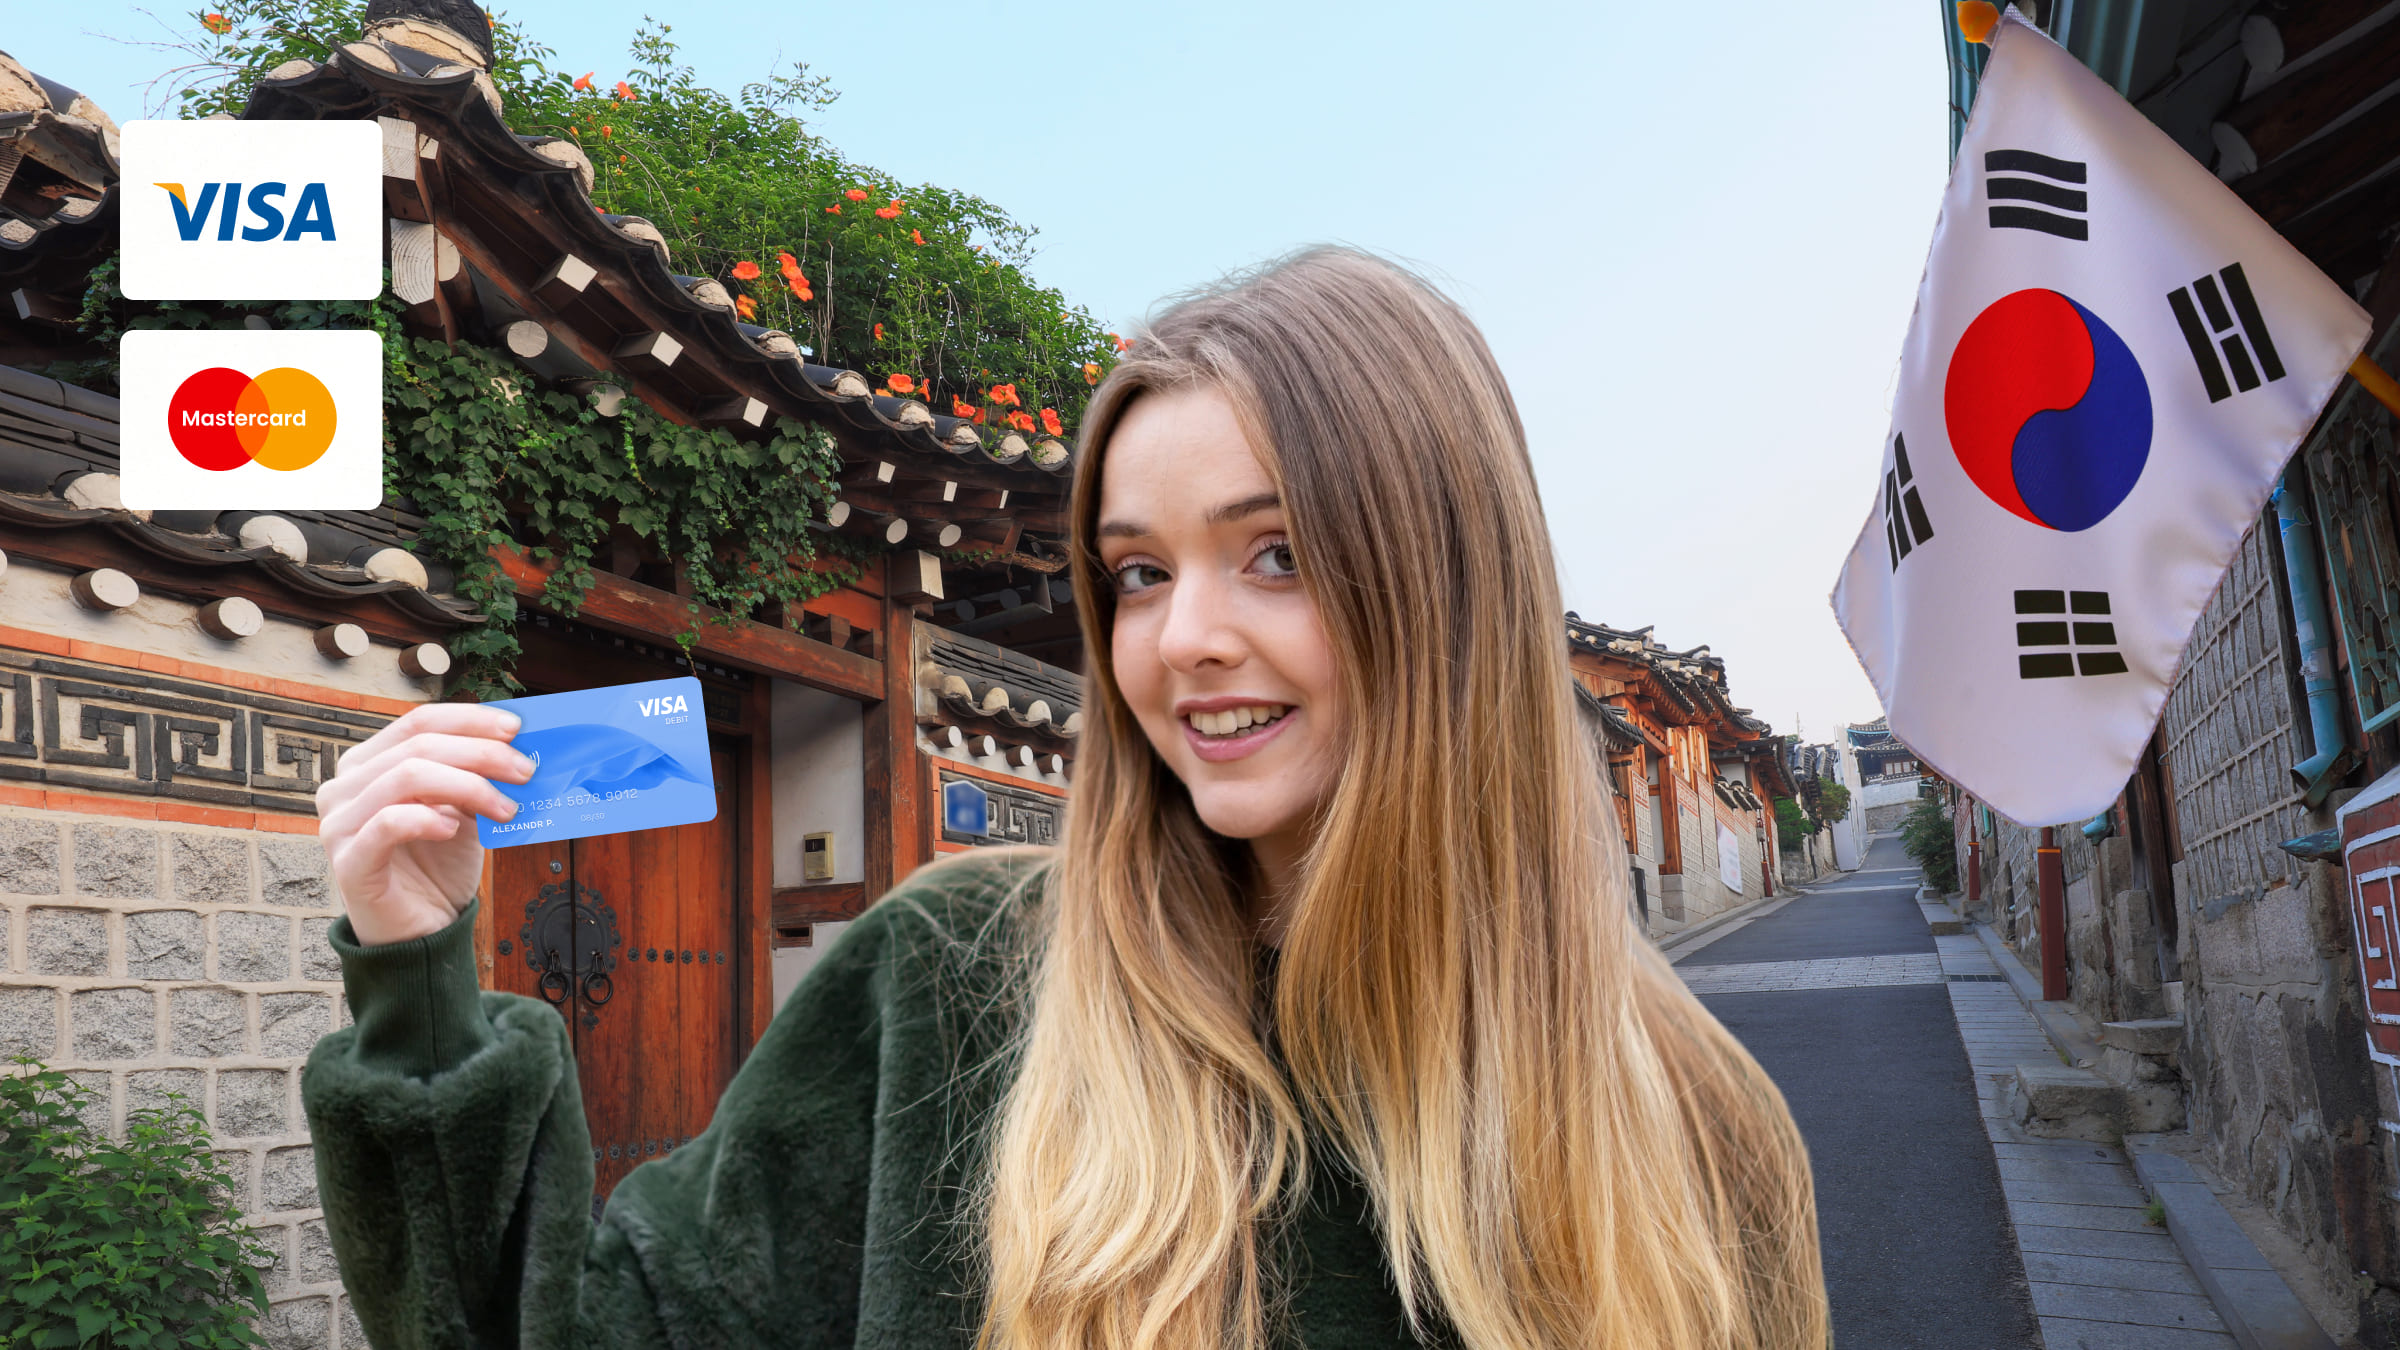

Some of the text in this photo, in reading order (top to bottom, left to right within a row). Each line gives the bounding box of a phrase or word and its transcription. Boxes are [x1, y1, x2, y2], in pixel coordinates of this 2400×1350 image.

[634, 695, 688, 717] VISA
[665, 715, 689, 726] DEBIT
[530, 797, 562, 812] 1234
[567, 792, 601, 807] 5678
[606, 788, 638, 802] 9012
[492, 819, 555, 834] ALEXANDR P.
